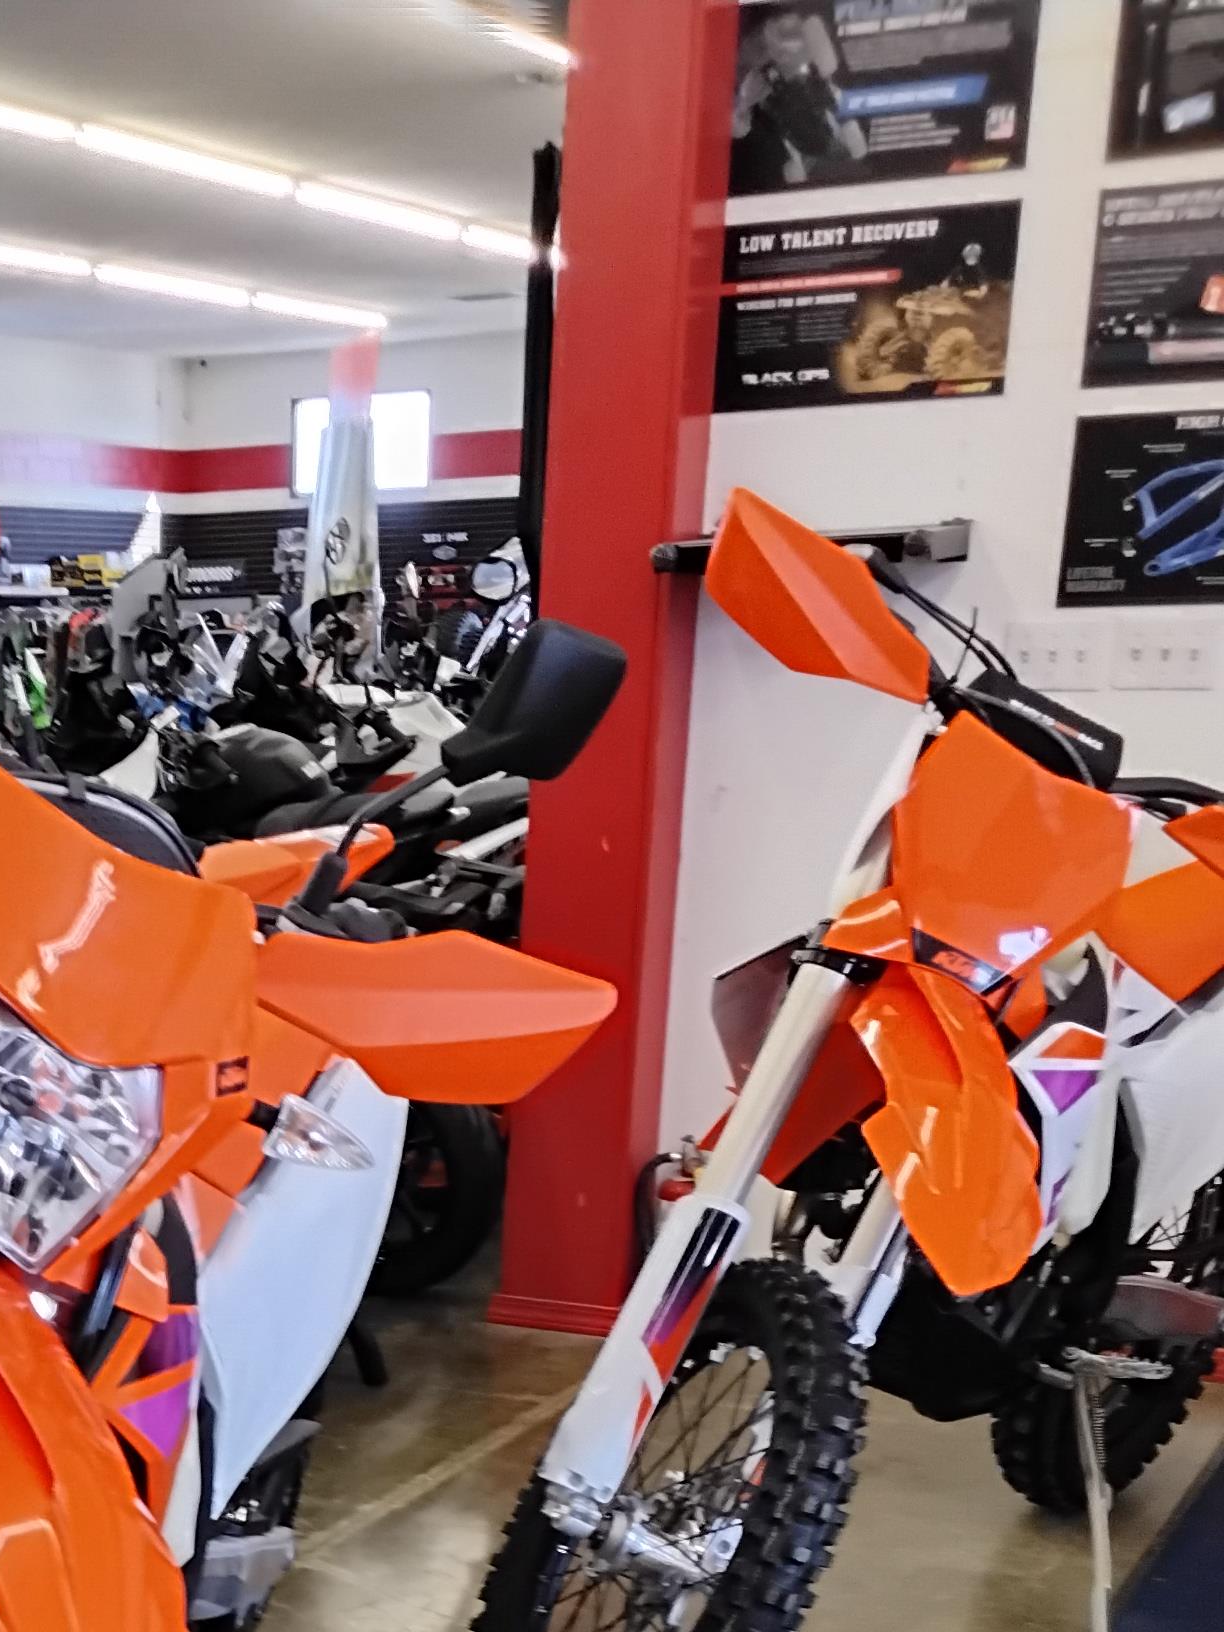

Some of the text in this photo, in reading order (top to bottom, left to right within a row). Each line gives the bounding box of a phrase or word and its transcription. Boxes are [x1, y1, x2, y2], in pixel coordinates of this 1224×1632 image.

[739, 219, 940, 254] LOW TALENT RECOVERY
